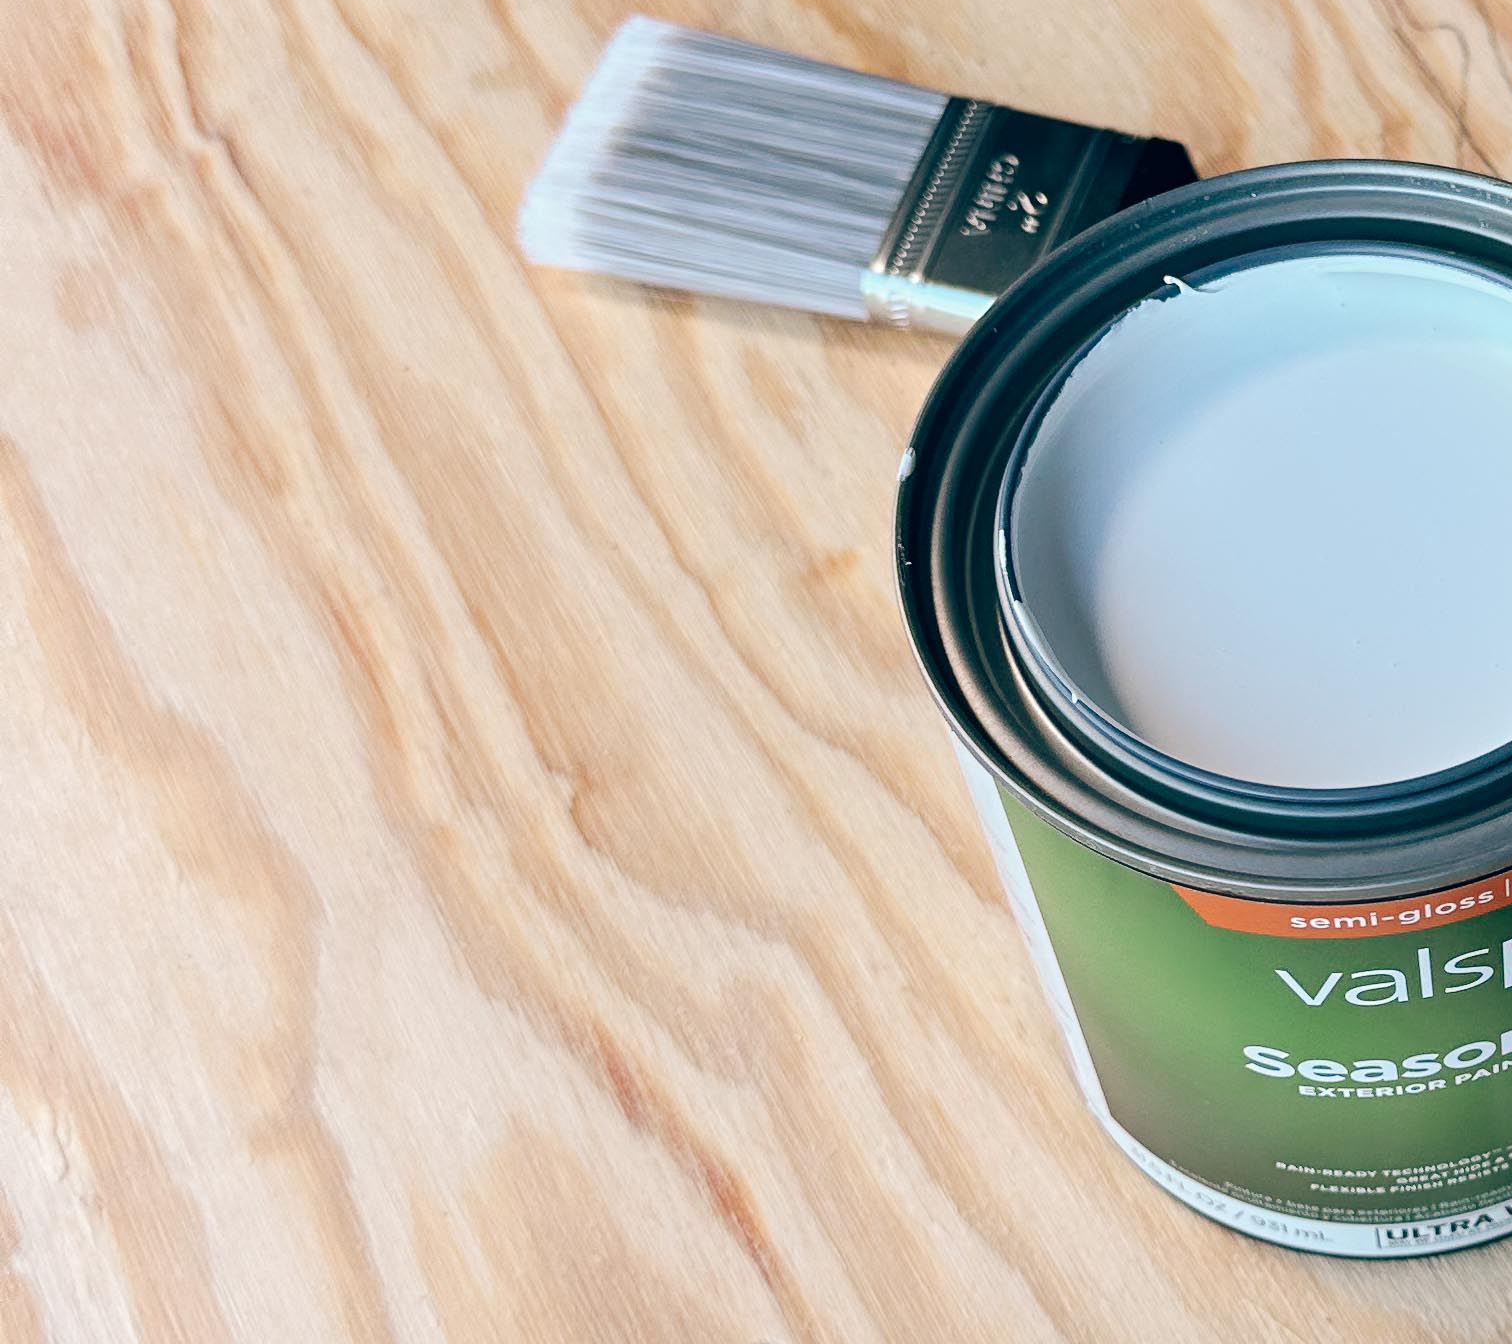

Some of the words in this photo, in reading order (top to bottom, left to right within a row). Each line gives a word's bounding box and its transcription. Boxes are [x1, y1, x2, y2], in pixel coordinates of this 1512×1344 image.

[1290, 888, 1494, 930] semi-gloss
[1299, 1078, 1447, 1099] EXTERIOR
[1385, 1213, 1494, 1241] ULTRA
